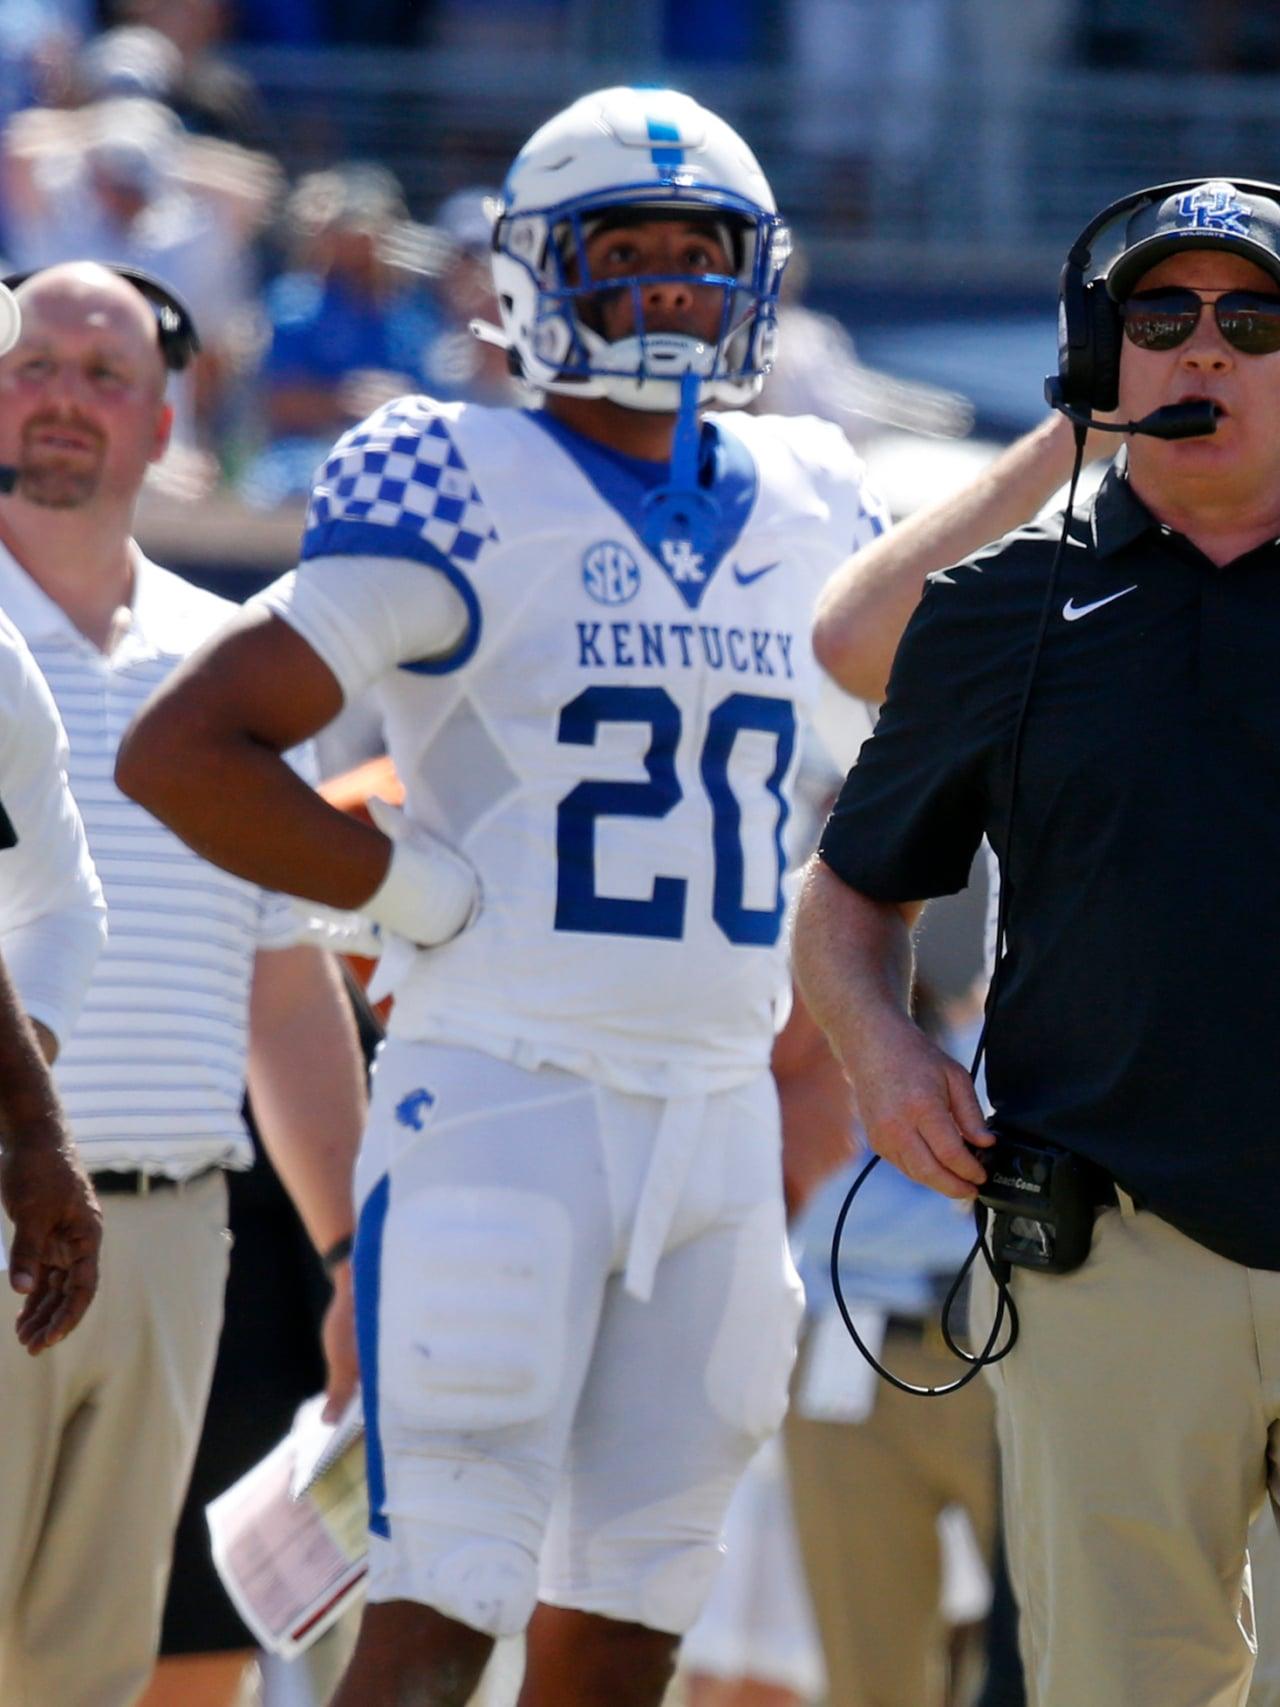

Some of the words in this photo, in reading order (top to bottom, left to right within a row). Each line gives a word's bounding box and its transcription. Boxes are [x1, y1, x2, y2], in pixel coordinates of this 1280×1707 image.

[583, 542, 641, 606] SEC
[660, 540, 705, 583] UK
[576, 621, 794, 679] KENTUCKY
[553, 684, 797, 947] 20
